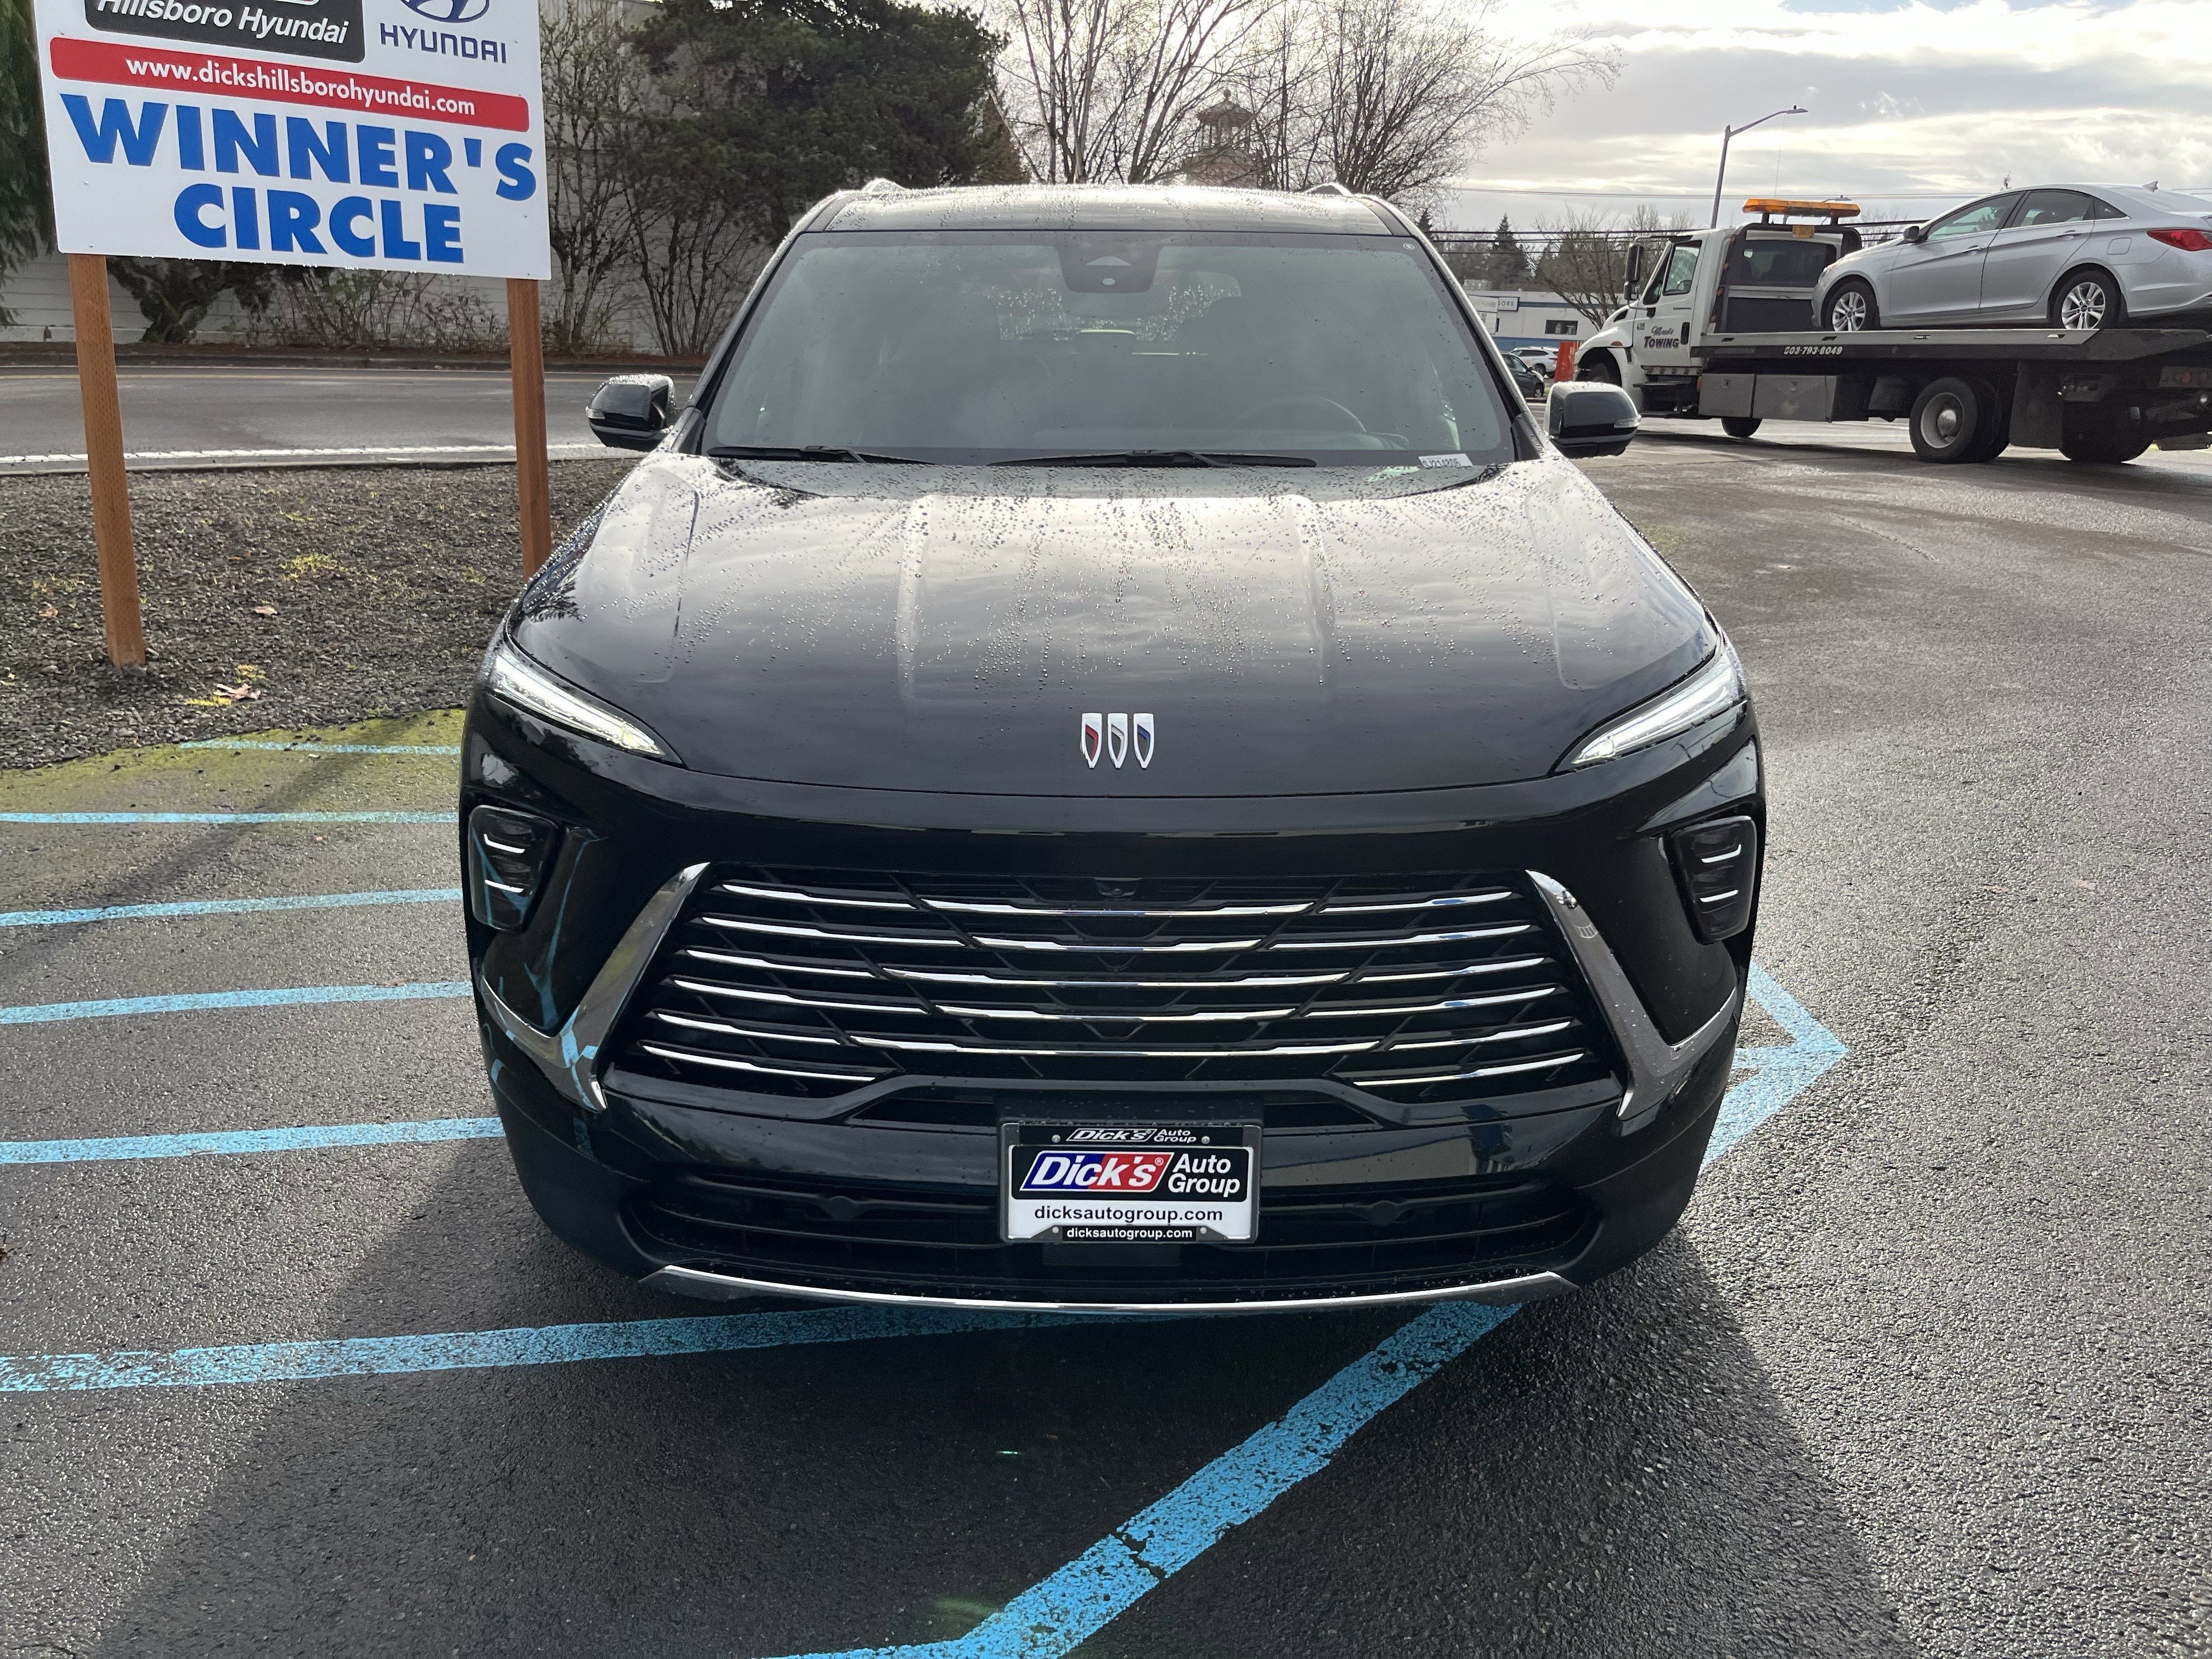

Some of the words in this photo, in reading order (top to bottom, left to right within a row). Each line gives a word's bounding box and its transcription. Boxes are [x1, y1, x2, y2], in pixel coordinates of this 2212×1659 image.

[238, 7, 349, 43] Hyundai
[380, 22, 506, 64] HYUNDAI
[126, 58, 475, 116] www.dickshillsborohyundai.com
[60, 93, 537, 202] WINNER'S
[173, 183, 465, 264] CIRCLE
[1644, 336, 1679, 348] TOWING
[1073, 1129, 1147, 1141] Dick's
[1153, 1135, 1197, 1143] Group
[1031, 1155, 1156, 1187] Dick's
[1173, 1153, 1231, 1174] Auto
[1167, 1173, 1240, 1198] Group
[1034, 1205, 1223, 1223] dicksautogroup.com
[1066, 1227, 1193, 1240] dicksautogroup.com
